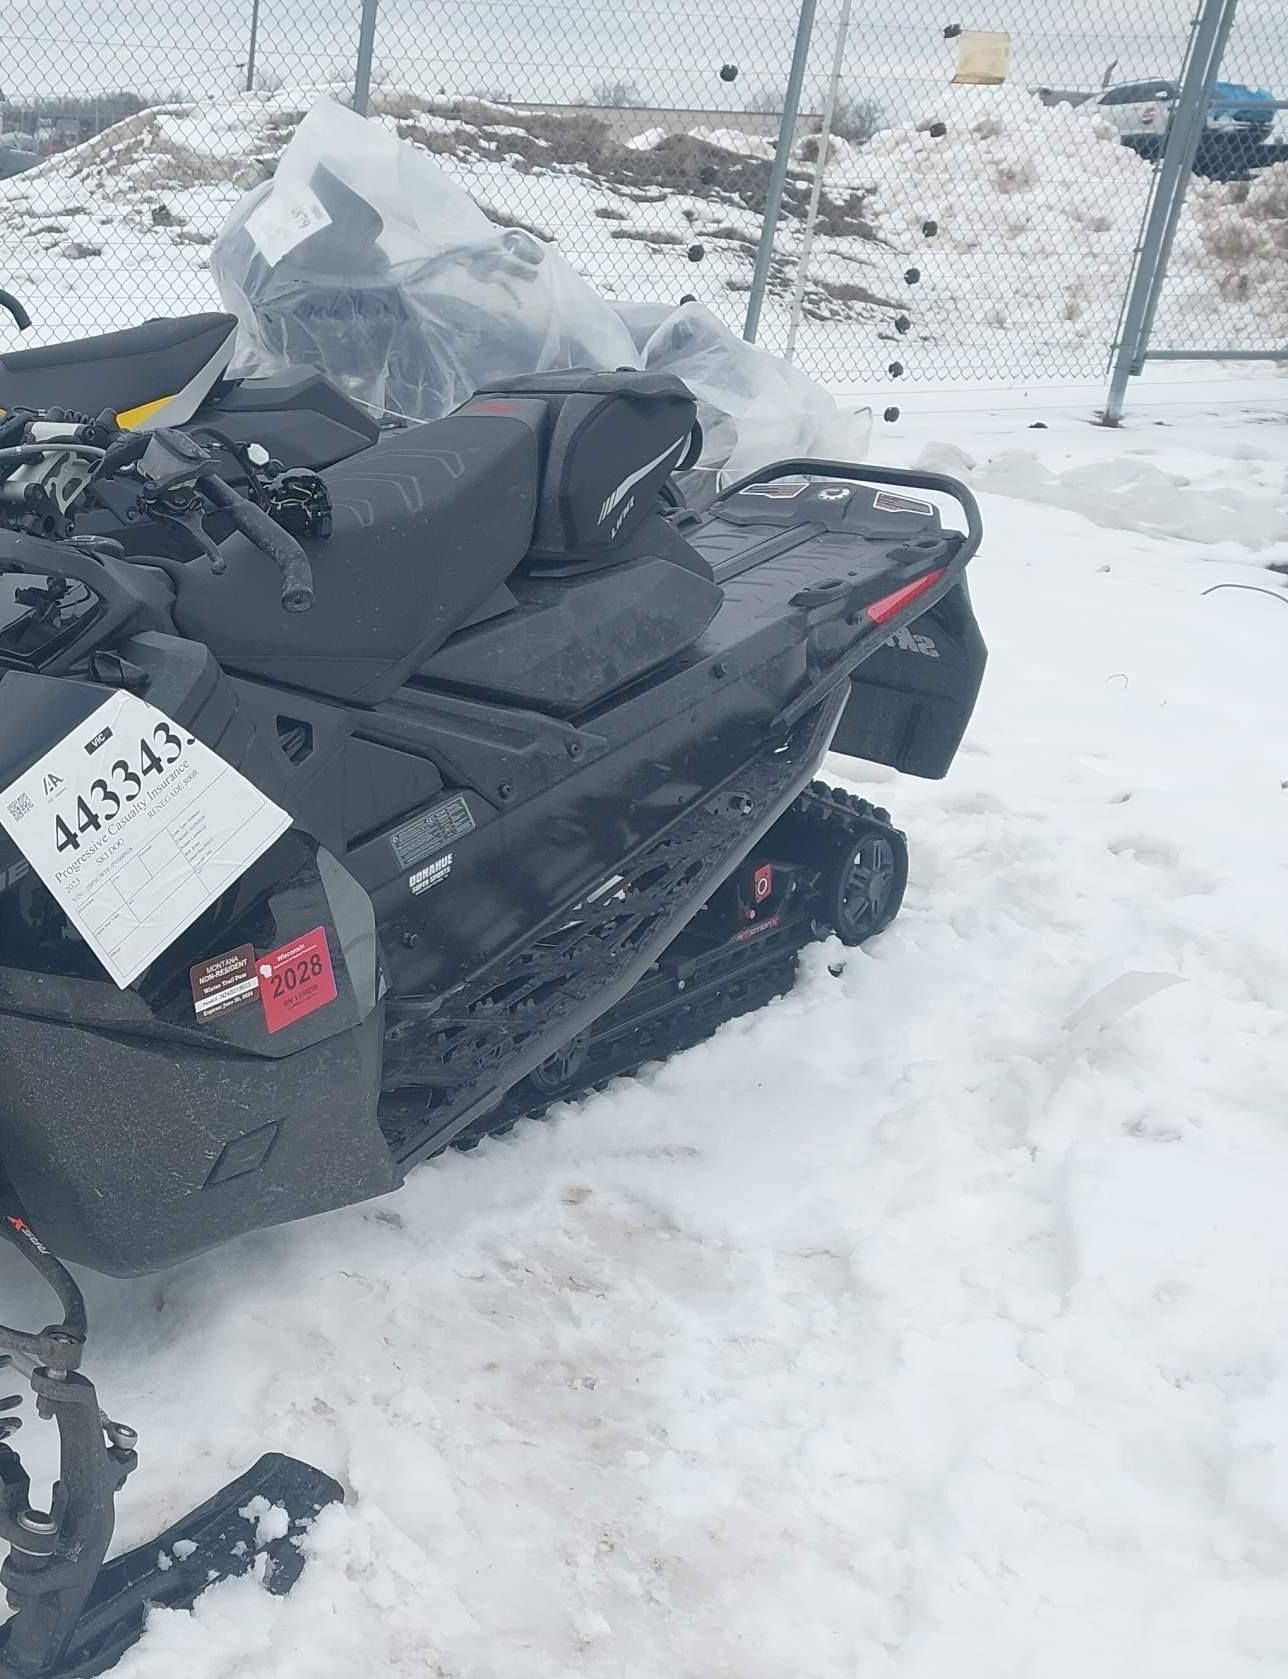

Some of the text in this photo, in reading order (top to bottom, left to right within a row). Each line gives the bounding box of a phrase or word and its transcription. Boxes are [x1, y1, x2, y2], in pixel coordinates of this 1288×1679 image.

[91, 733, 106, 748] VIC
[55, 722, 195, 852] 443343
[54, 833, 109, 884] Progressive
[108, 799, 148, 835] Casualty
[148, 759, 190, 800] Insurance
[409, 853, 453, 887] DONAHUE
[205, 955, 239, 974] MONTANA
[277, 943, 305, 962] Wisconsin
[199, 959, 248, 984] NON-RESIDENT
[271, 954, 322, 999] 2028
